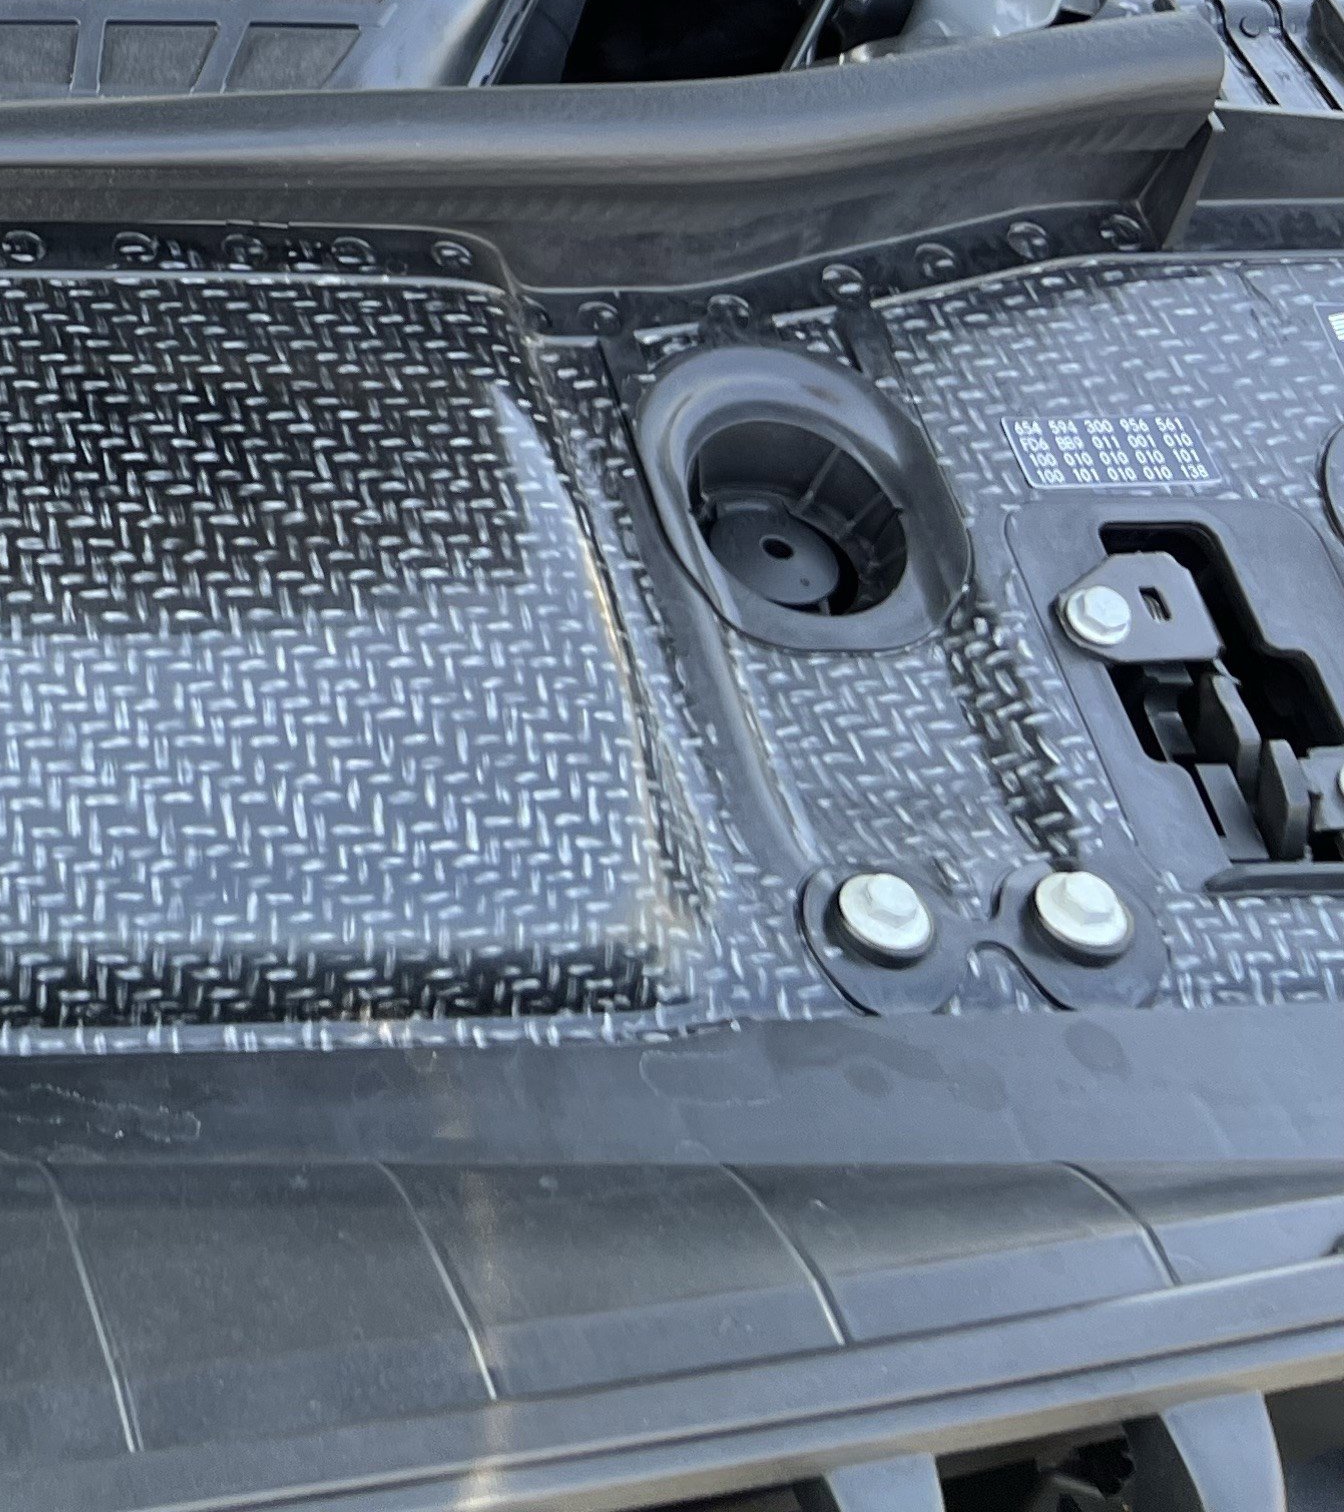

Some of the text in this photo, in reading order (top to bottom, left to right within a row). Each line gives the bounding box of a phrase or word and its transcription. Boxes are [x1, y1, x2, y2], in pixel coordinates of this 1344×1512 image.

[1014, 417, 1184, 436] 654 594 300 956 561
[1020, 437, 1050, 452] FD6
[1092, 435, 1121, 449] 011
[1127, 434, 1157, 448] 001
[1163, 433, 1193, 447] 010
[1029, 448, 1201, 467] 100 010 010 010 101
[1036, 465, 1209, 484] 100 101 010 010 138
